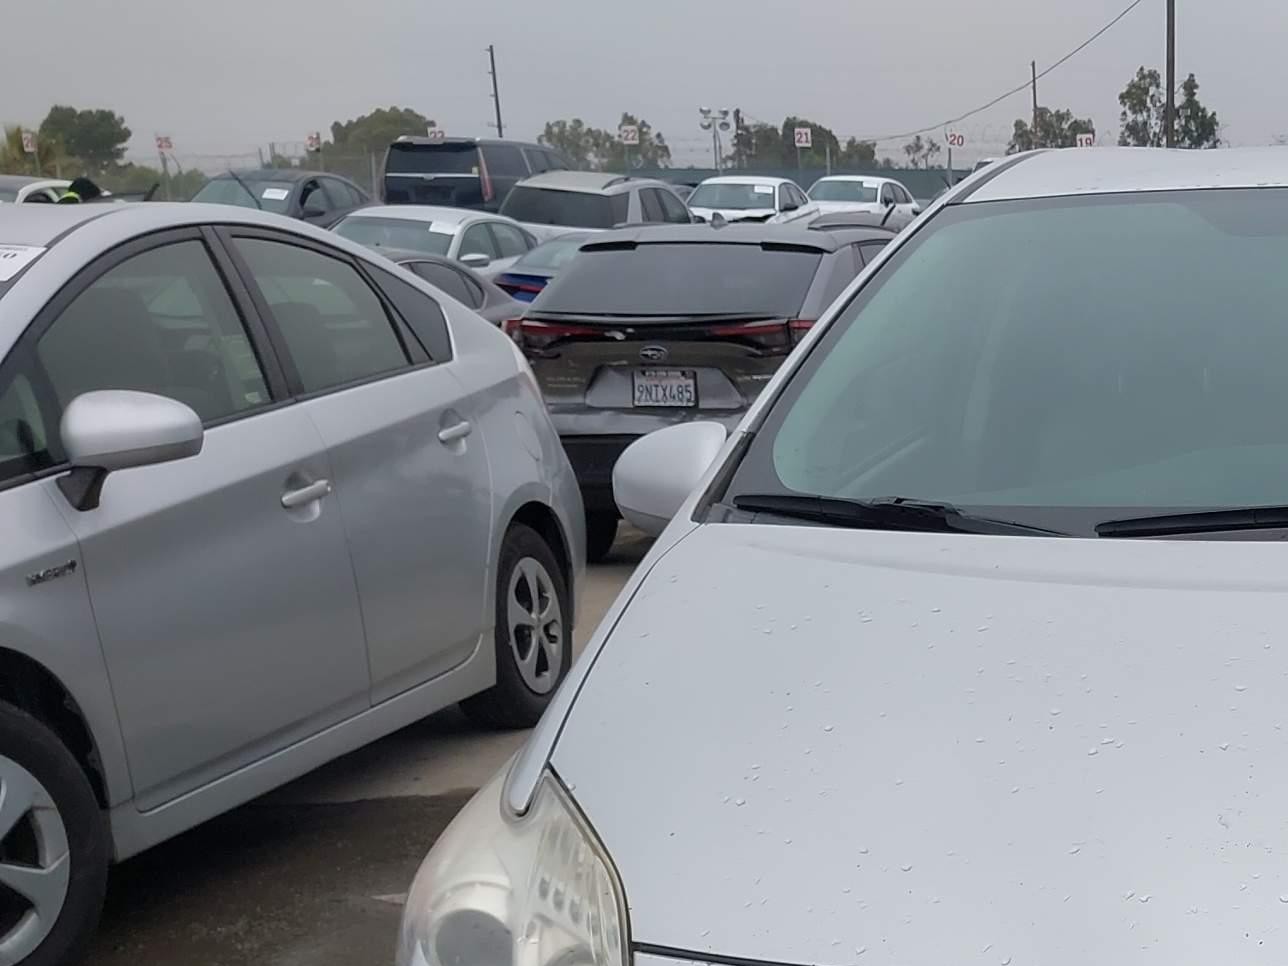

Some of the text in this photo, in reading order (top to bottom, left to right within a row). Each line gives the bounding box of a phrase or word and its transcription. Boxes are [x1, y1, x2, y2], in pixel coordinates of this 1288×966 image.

[623, 130, 638, 142] 22
[796, 132, 811, 145] 21
[949, 134, 964, 147] 20
